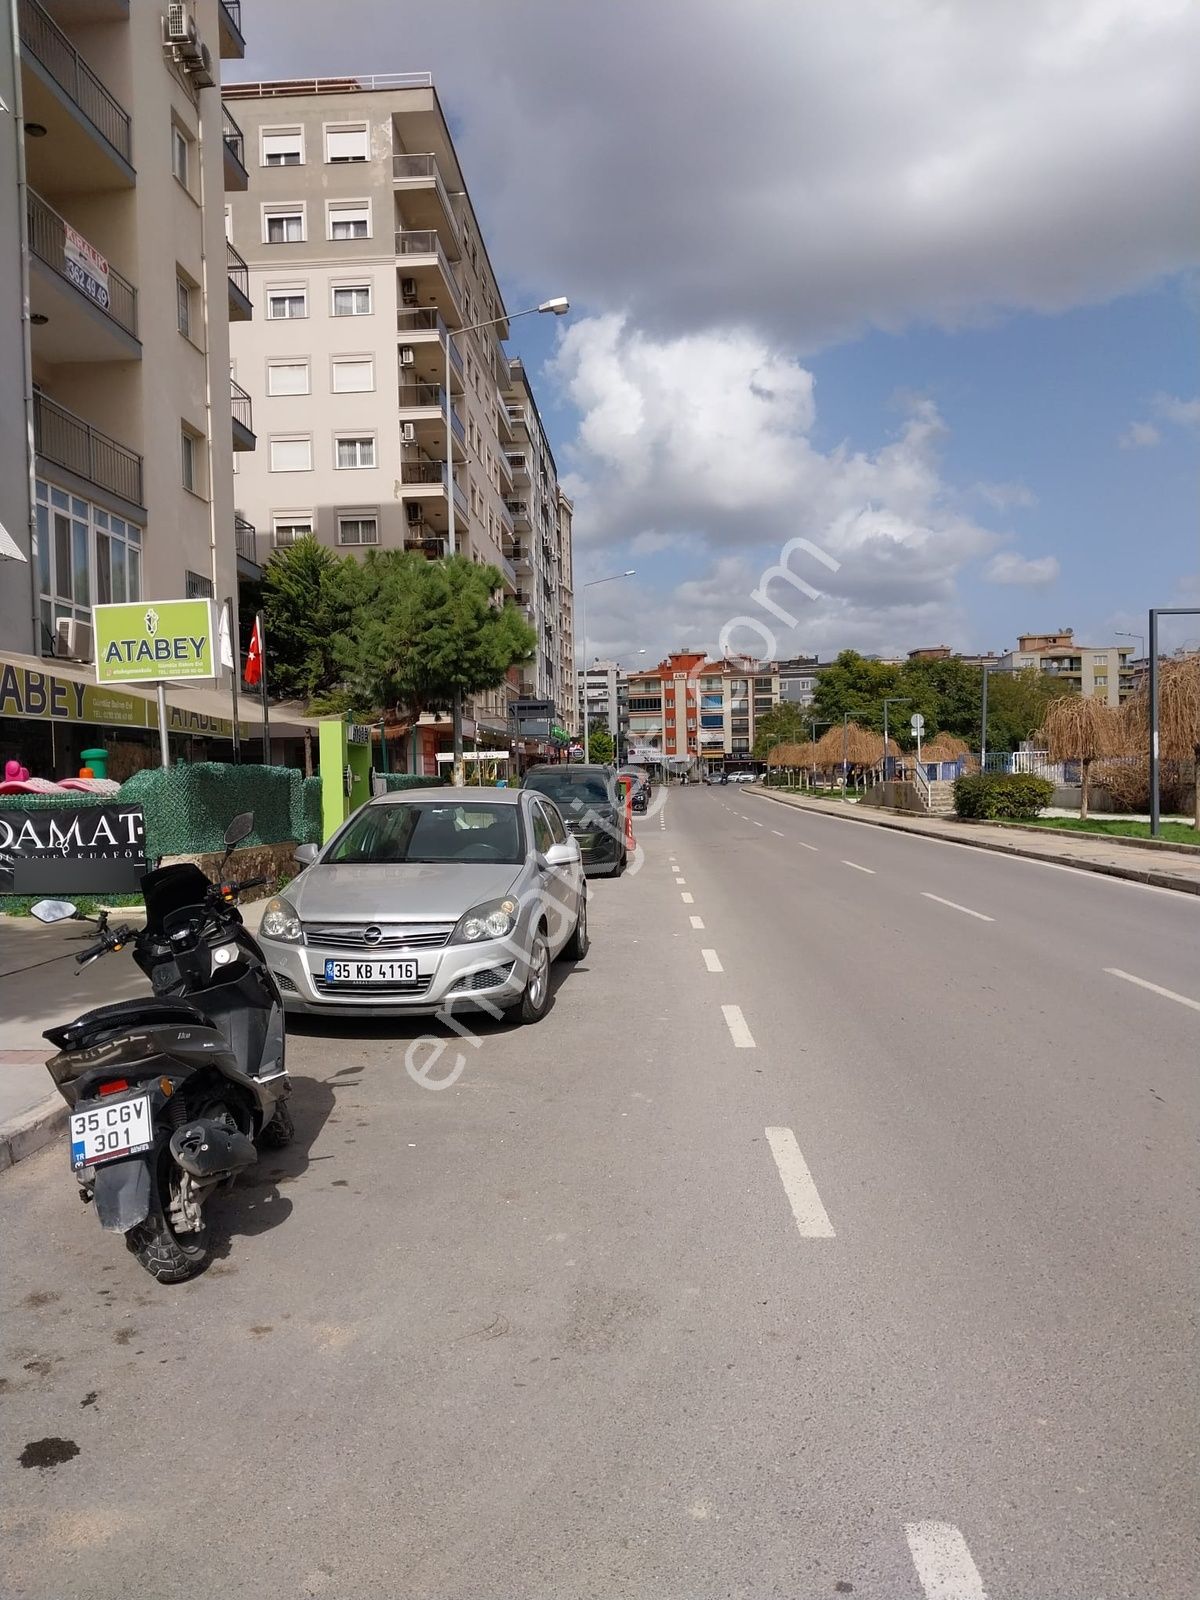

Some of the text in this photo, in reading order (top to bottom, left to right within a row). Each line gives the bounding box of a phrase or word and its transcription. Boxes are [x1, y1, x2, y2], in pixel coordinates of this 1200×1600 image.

[105, 636, 206, 662] ATABEY
[334, 964, 350, 978] 35
[356, 964, 373, 979] KB
[379, 964, 413, 978] 4116
[74, 1101, 143, 1135] 35 CGV
[94, 1127, 130, 1153] 301
[76, 1153, 85, 1161] TR
